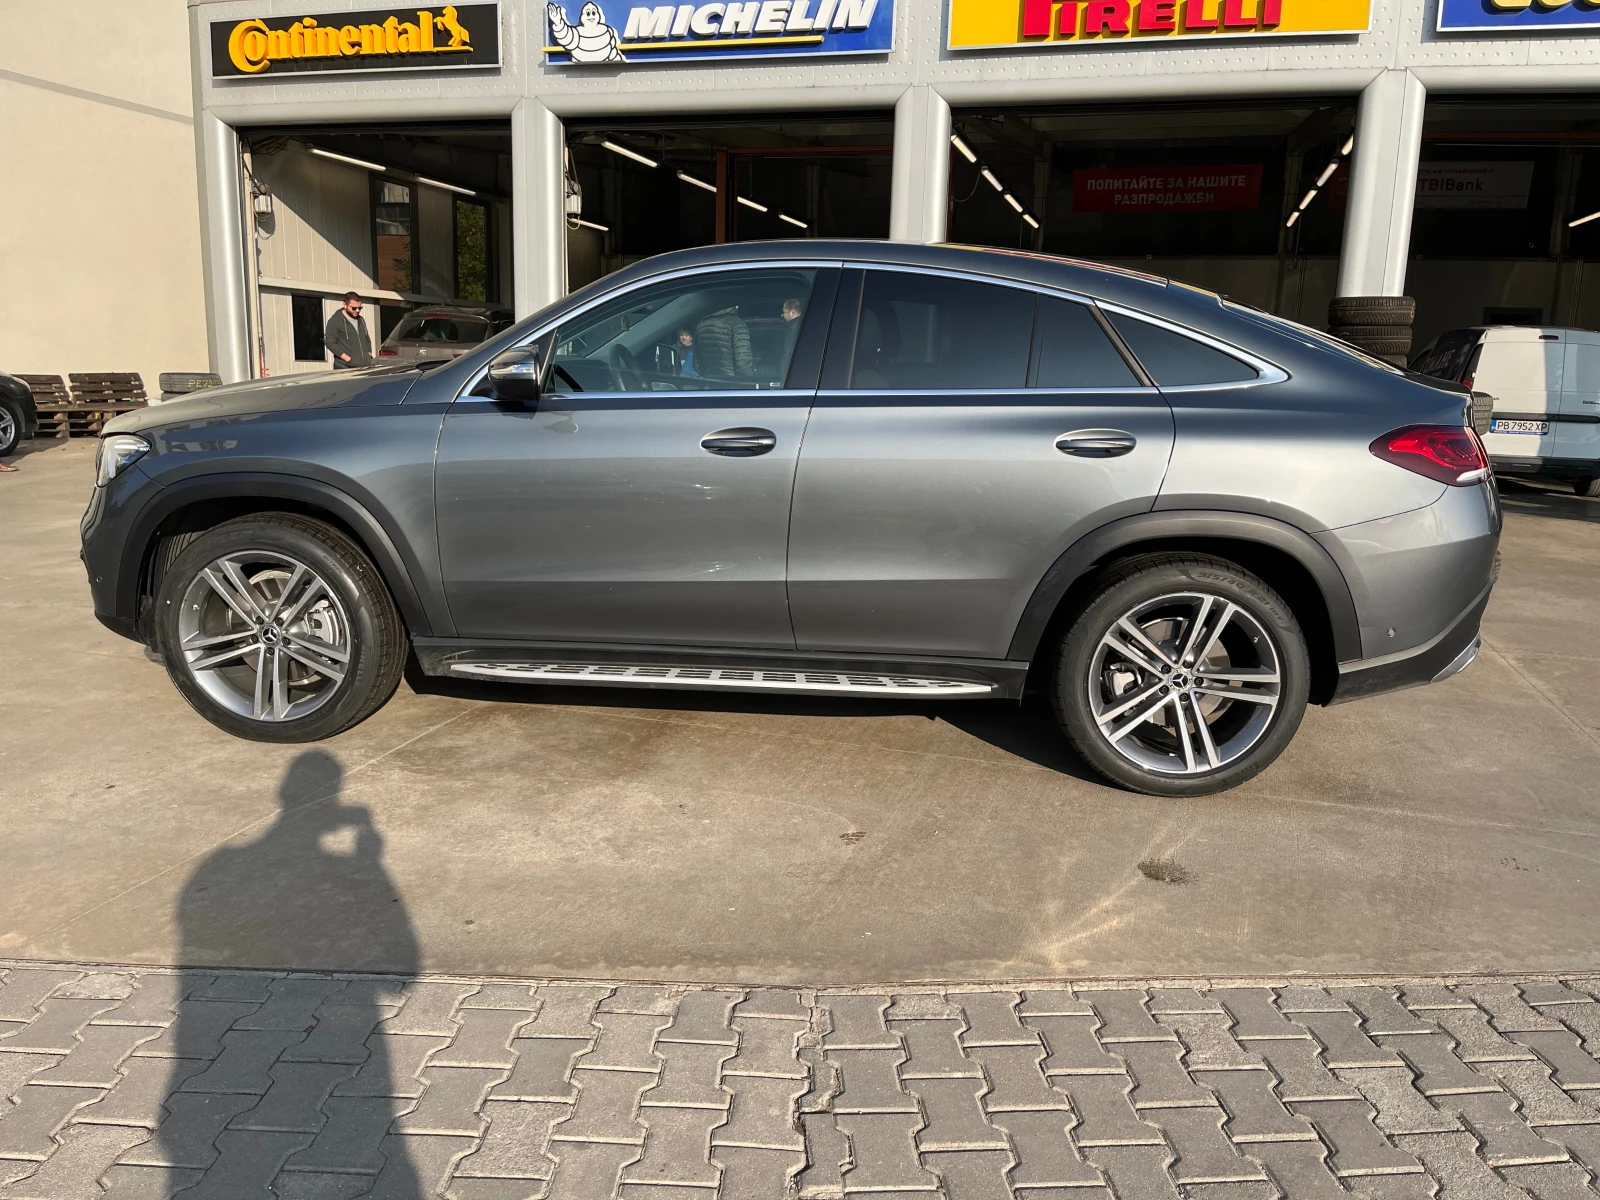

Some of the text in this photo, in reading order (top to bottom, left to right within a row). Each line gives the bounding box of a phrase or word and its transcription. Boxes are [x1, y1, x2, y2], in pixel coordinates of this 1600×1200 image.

[622, 0, 879, 40] MICHELIN
[228, 11, 435, 73] Continental
[1087, 175, 1247, 190] ПОПИТАЙТЕ ЗА НАШИТЕ
[1418, 178, 1483, 191] TBIBank
[1114, 192, 1215, 206] РАЗПРОДАЖБИ
[1497, 421, 1510, 430] PB
[1511, 421, 1534, 431] 7952
[1535, 422, 1548, 432] XP
